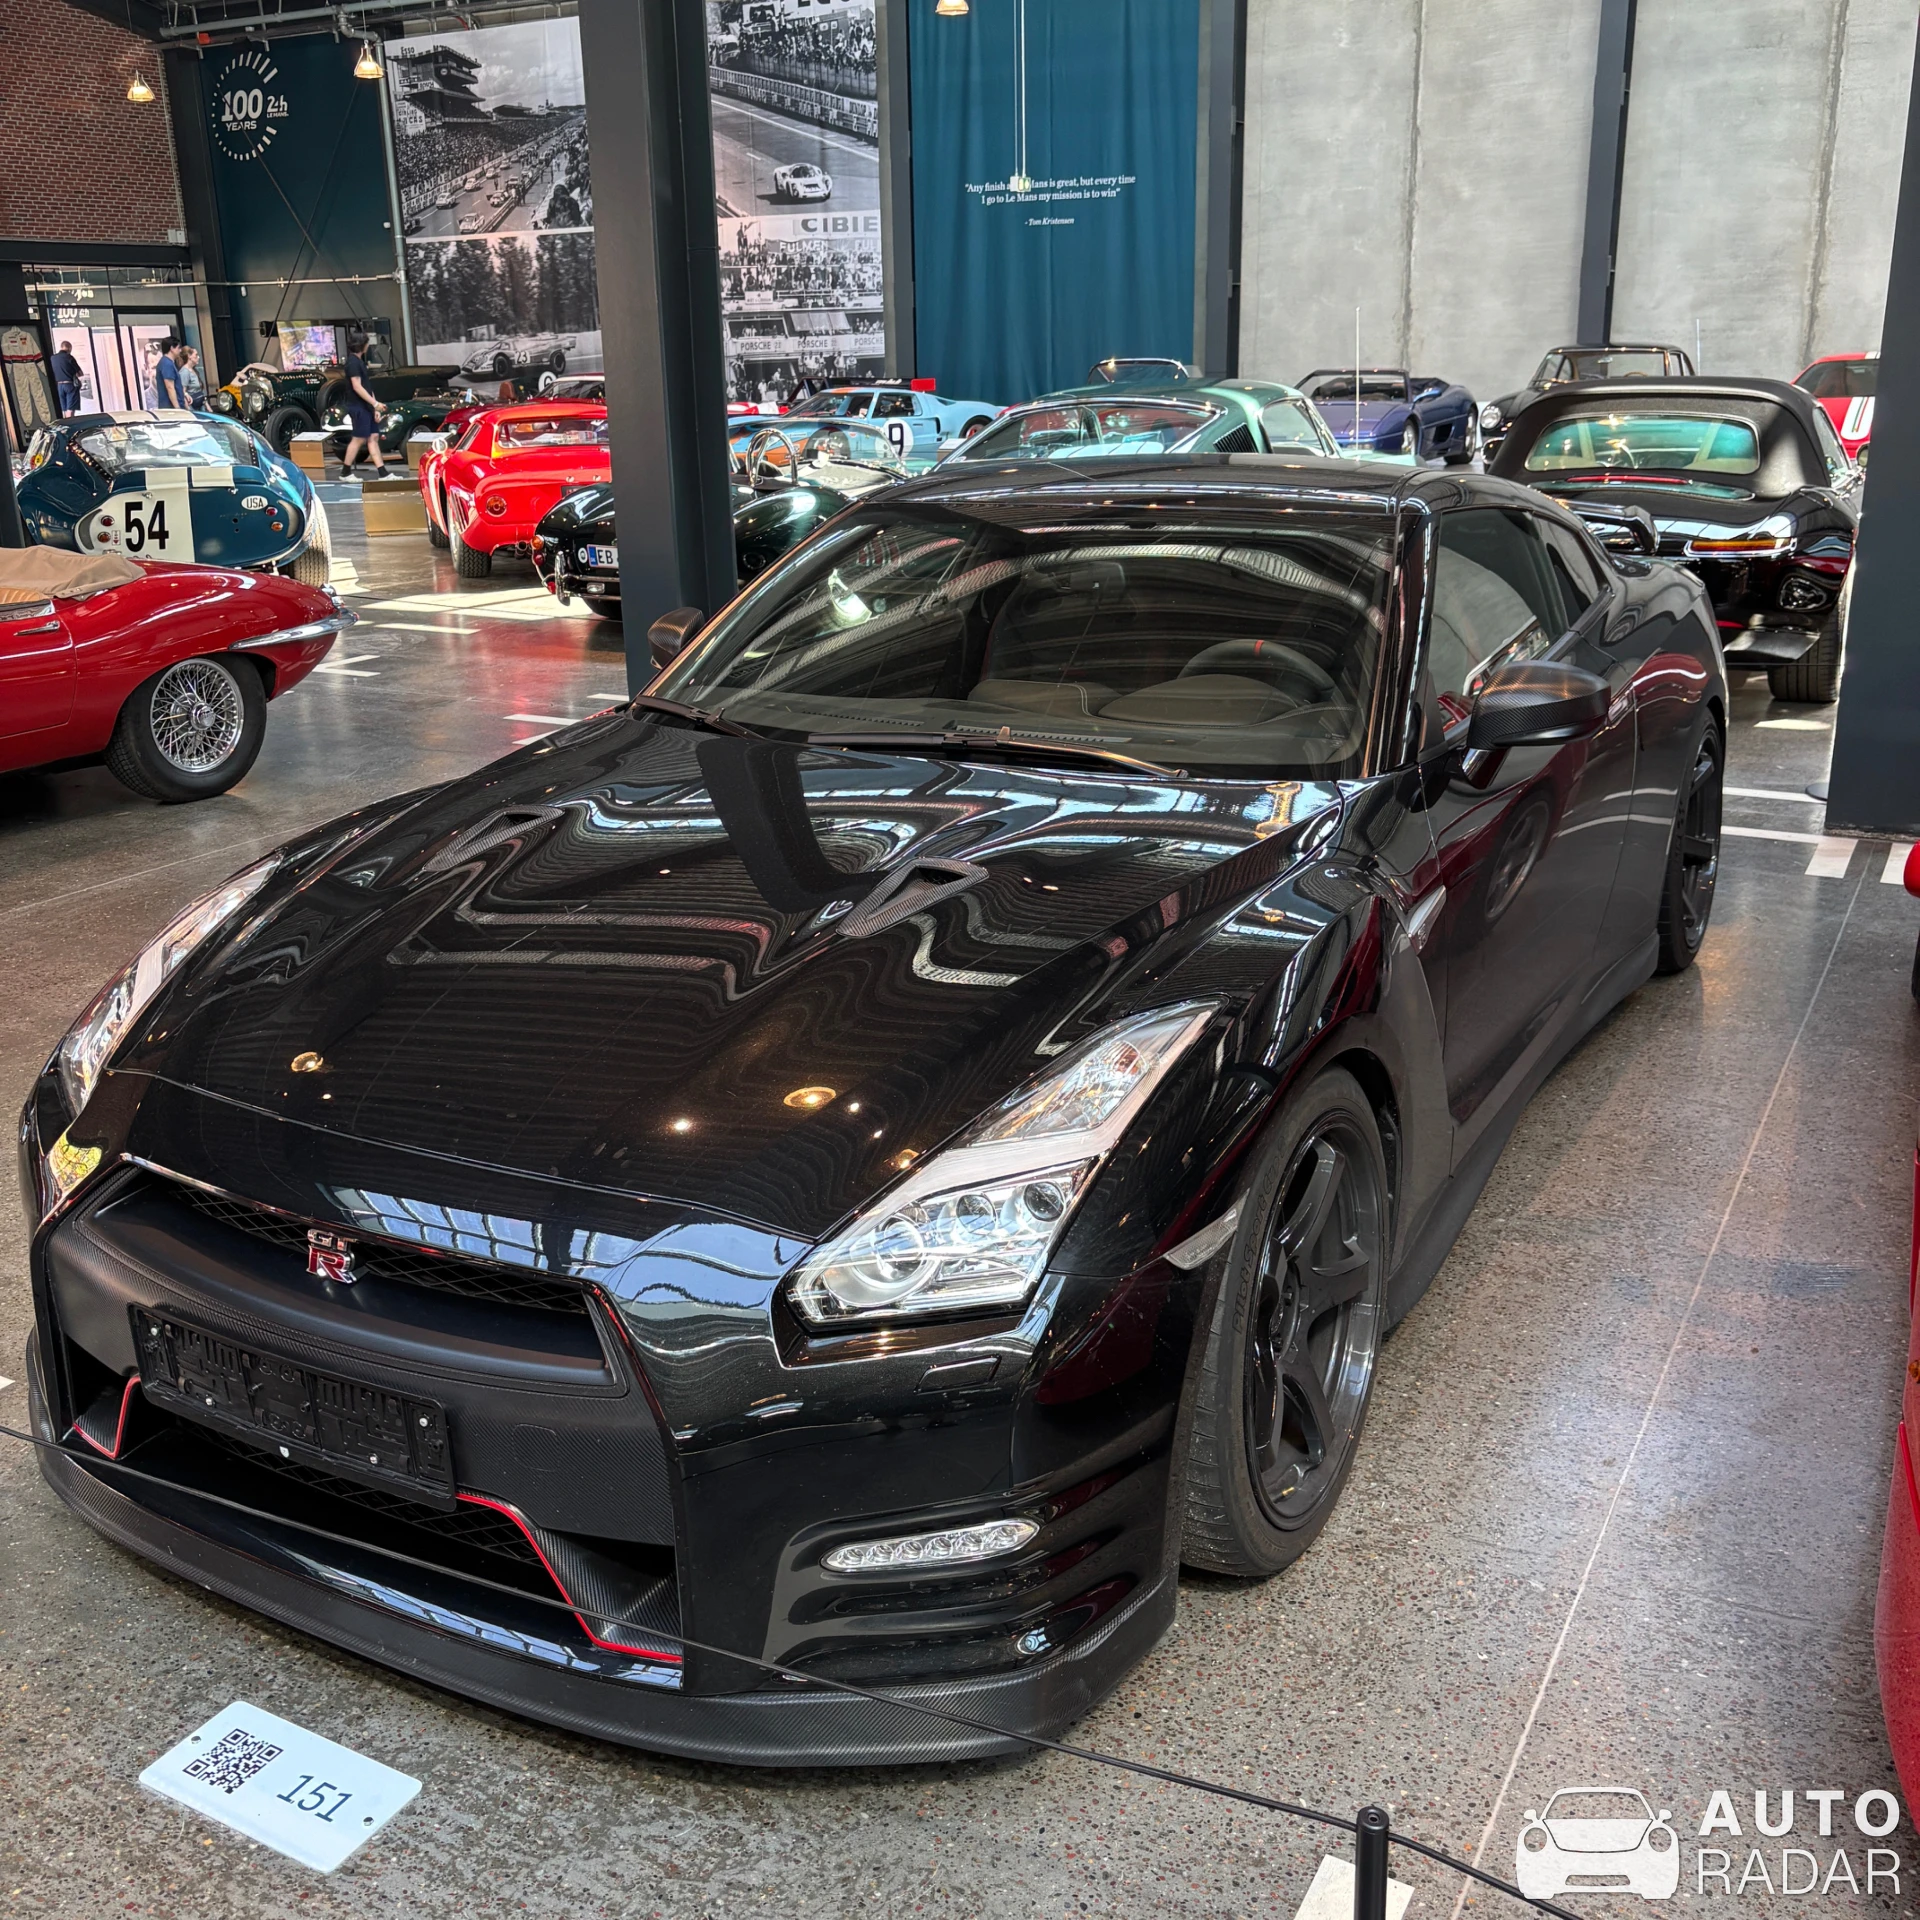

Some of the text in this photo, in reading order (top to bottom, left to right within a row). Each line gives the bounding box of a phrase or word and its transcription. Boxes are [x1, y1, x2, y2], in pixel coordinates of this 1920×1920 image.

[221, 88, 263, 121] 100
[266, 95, 288, 112] 24h
[226, 120, 257, 131] YEARS
[985, 181, 1006, 192] finish
[1049, 178, 1056, 188] is
[1056, 177, 1079, 189] great,
[1080, 176, 1094, 186] but
[1094, 176, 1117, 187] every
[1118, 174, 1136, 185] time
[981, 194, 986, 204] I
[986, 196, 995, 206] go
[996, 194, 1004, 203] to
[1005, 193, 1016, 203] Le
[1017, 193, 1038, 202] Mans
[1039, 193, 1051, 203] my
[1051, 189, 1082, 200] mission
[1083, 189, 1091, 199] is
[1091, 189, 1100, 199] to
[801, 216, 878, 233] CIBIE
[1028, 218, 1042, 226] Tom
[1042, 216, 1075, 226] Kristensen
[740, 341, 771, 351] PORSCHE
[797, 339, 828, 349] PORSCHE
[516, 350, 528, 363] 23
[888, 423, 904, 459] 9
[246, 497, 264, 509] USA
[125, 500, 169, 552] 54
[597, 549, 614, 565] EB
[276, 1774, 353, 1823] 151
